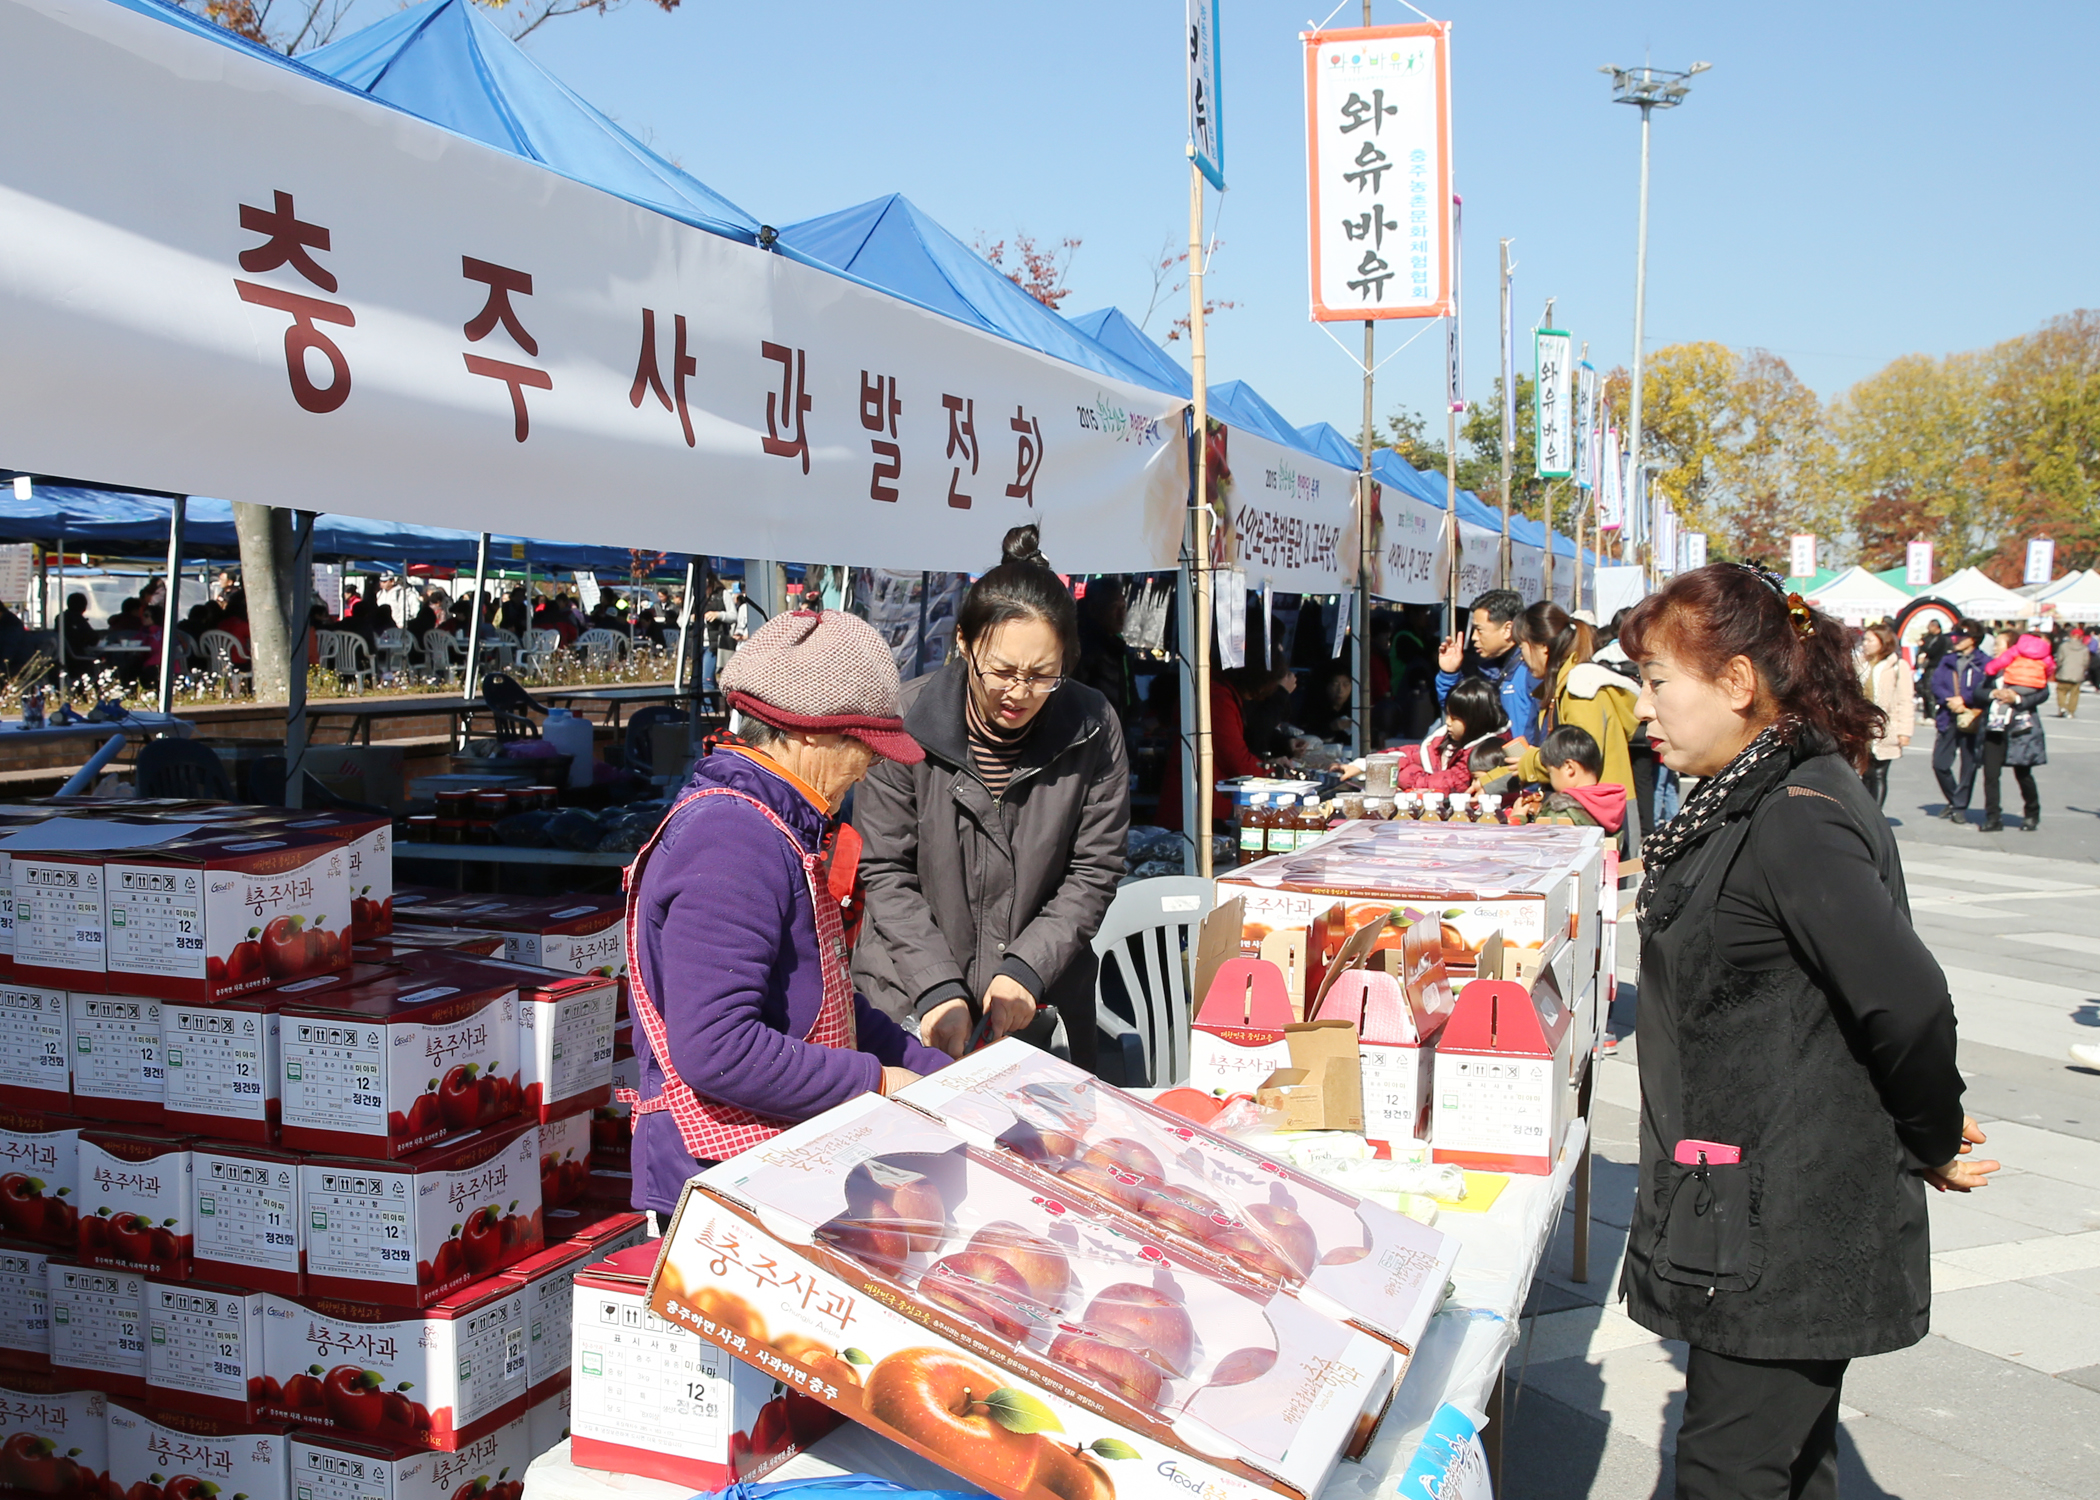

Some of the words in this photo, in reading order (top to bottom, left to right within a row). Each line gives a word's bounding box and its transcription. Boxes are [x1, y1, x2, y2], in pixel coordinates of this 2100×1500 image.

[1339, 89, 1398, 303] 와유바유
[1409, 147, 1429, 299] 충주농촌문화체험협회
[1077, 406, 1098, 430] 2015
[1541, 361, 1558, 468] 와유바유
[1266, 469, 1277, 489] 2015
[1236, 504, 1303, 569] 수안보곤충박물관
[1304, 523, 1310, 564] &
[1311, 524, 1340, 572] 교육농장
[245, 878, 314, 916] 충주사과
[176, 910, 196, 918] 미야마
[1474, 907, 1498, 917] Good
[0, 919, 12, 928] 정건
[179, 921, 190, 933] 12
[77, 930, 101, 942] 정건화
[176, 937, 203, 949] 정건화
[569, 935, 619, 969] 충주사과
[42, 1027, 60, 1035] 미야마
[1221, 1031, 1245, 1040] 대한민국
[45, 1043, 56, 1054] 12
[425, 1024, 487, 1067] 충주사과
[597, 1037, 605, 1048] 12
[141, 1048, 152, 1060] 12
[235, 1051, 256, 1059] 미야마
[594, 1048, 611, 1062] 정건화
[40, 1056, 64, 1066] 정건화
[1209, 1055, 1279, 1075] 충주사과
[237, 1063, 248, 1076] 12
[356, 1065, 377, 1073] 미야마
[233, 1082, 260, 1094] 정건화
[357, 1078, 369, 1089] 12
[353, 1093, 381, 1107] 정건화
[1386, 1095, 1398, 1105] 12
[1514, 1125, 1542, 1136] 정건화
[94, 1169, 161, 1194] 충주사과
[449, 1165, 508, 1212] 충주사과
[264, 1199, 284, 1211] 미야마
[268, 1213, 279, 1225] 11
[383, 1214, 404, 1222] 미야마
[266, 1232, 294, 1245] 정건화
[385, 1226, 398, 1238] 12
[381, 1249, 410, 1261] 정건화
[695, 1226, 856, 1330] 충주사과
[33, 1303, 42, 1314] 11
[318, 1302, 347, 1313] 대한민국
[864, 1283, 896, 1304] 대한민국
[897, 1299, 931, 1323] 중심고을
[268, 1306, 285, 1318] Good
[781, 1302, 813, 1325] Chungju
[815, 1320, 840, 1339] Apple
[122, 1324, 133, 1335] 12
[119, 1339, 144, 1351] 정건화
[306, 1323, 398, 1361] 충주사과
[219, 1344, 232, 1356] 12
[509, 1344, 518, 1357] 12
[666, 1300, 716, 1335] 충주하면
[717, 1329, 750, 1354] 사과,
[755, 1350, 808, 1385] 사과하면
[809, 1377, 839, 1400] 충주
[214, 1362, 241, 1376] 정건화
[507, 1358, 524, 1373] 정건화
[685, 1361, 716, 1377] 미야마
[687, 1383, 704, 1401] 12
[270, 1409, 288, 1418] 충주하면
[324, 1418, 334, 1427] 충주
[148, 1436, 233, 1472] 충주사과
[432, 1435, 498, 1490] 충주사과
[1157, 1461, 1205, 1494] Good
